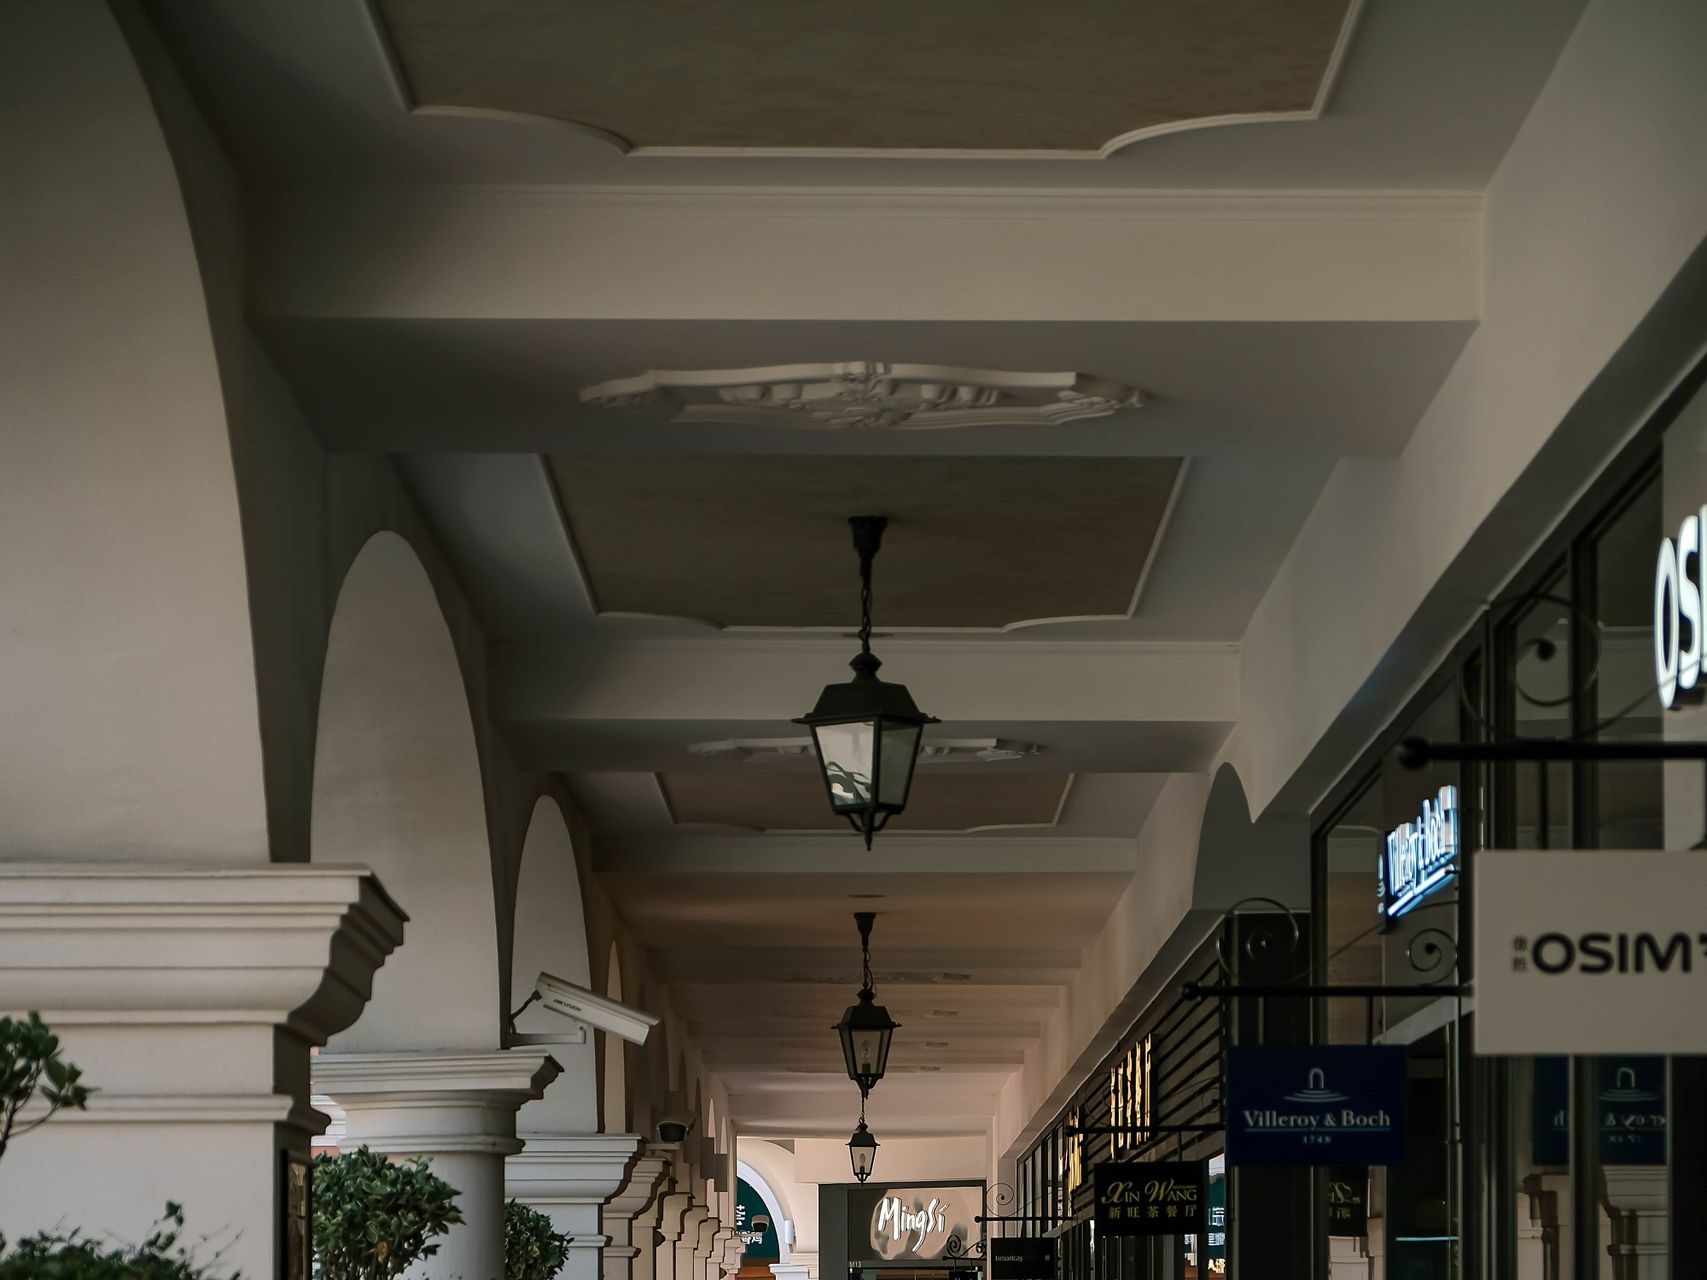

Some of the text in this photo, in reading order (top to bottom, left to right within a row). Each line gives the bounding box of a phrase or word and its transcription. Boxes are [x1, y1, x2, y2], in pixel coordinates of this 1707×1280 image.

[1243, 1109, 1391, 1131] Villeroy & Boch
[1302, 1134, 1332, 1145] 1748
